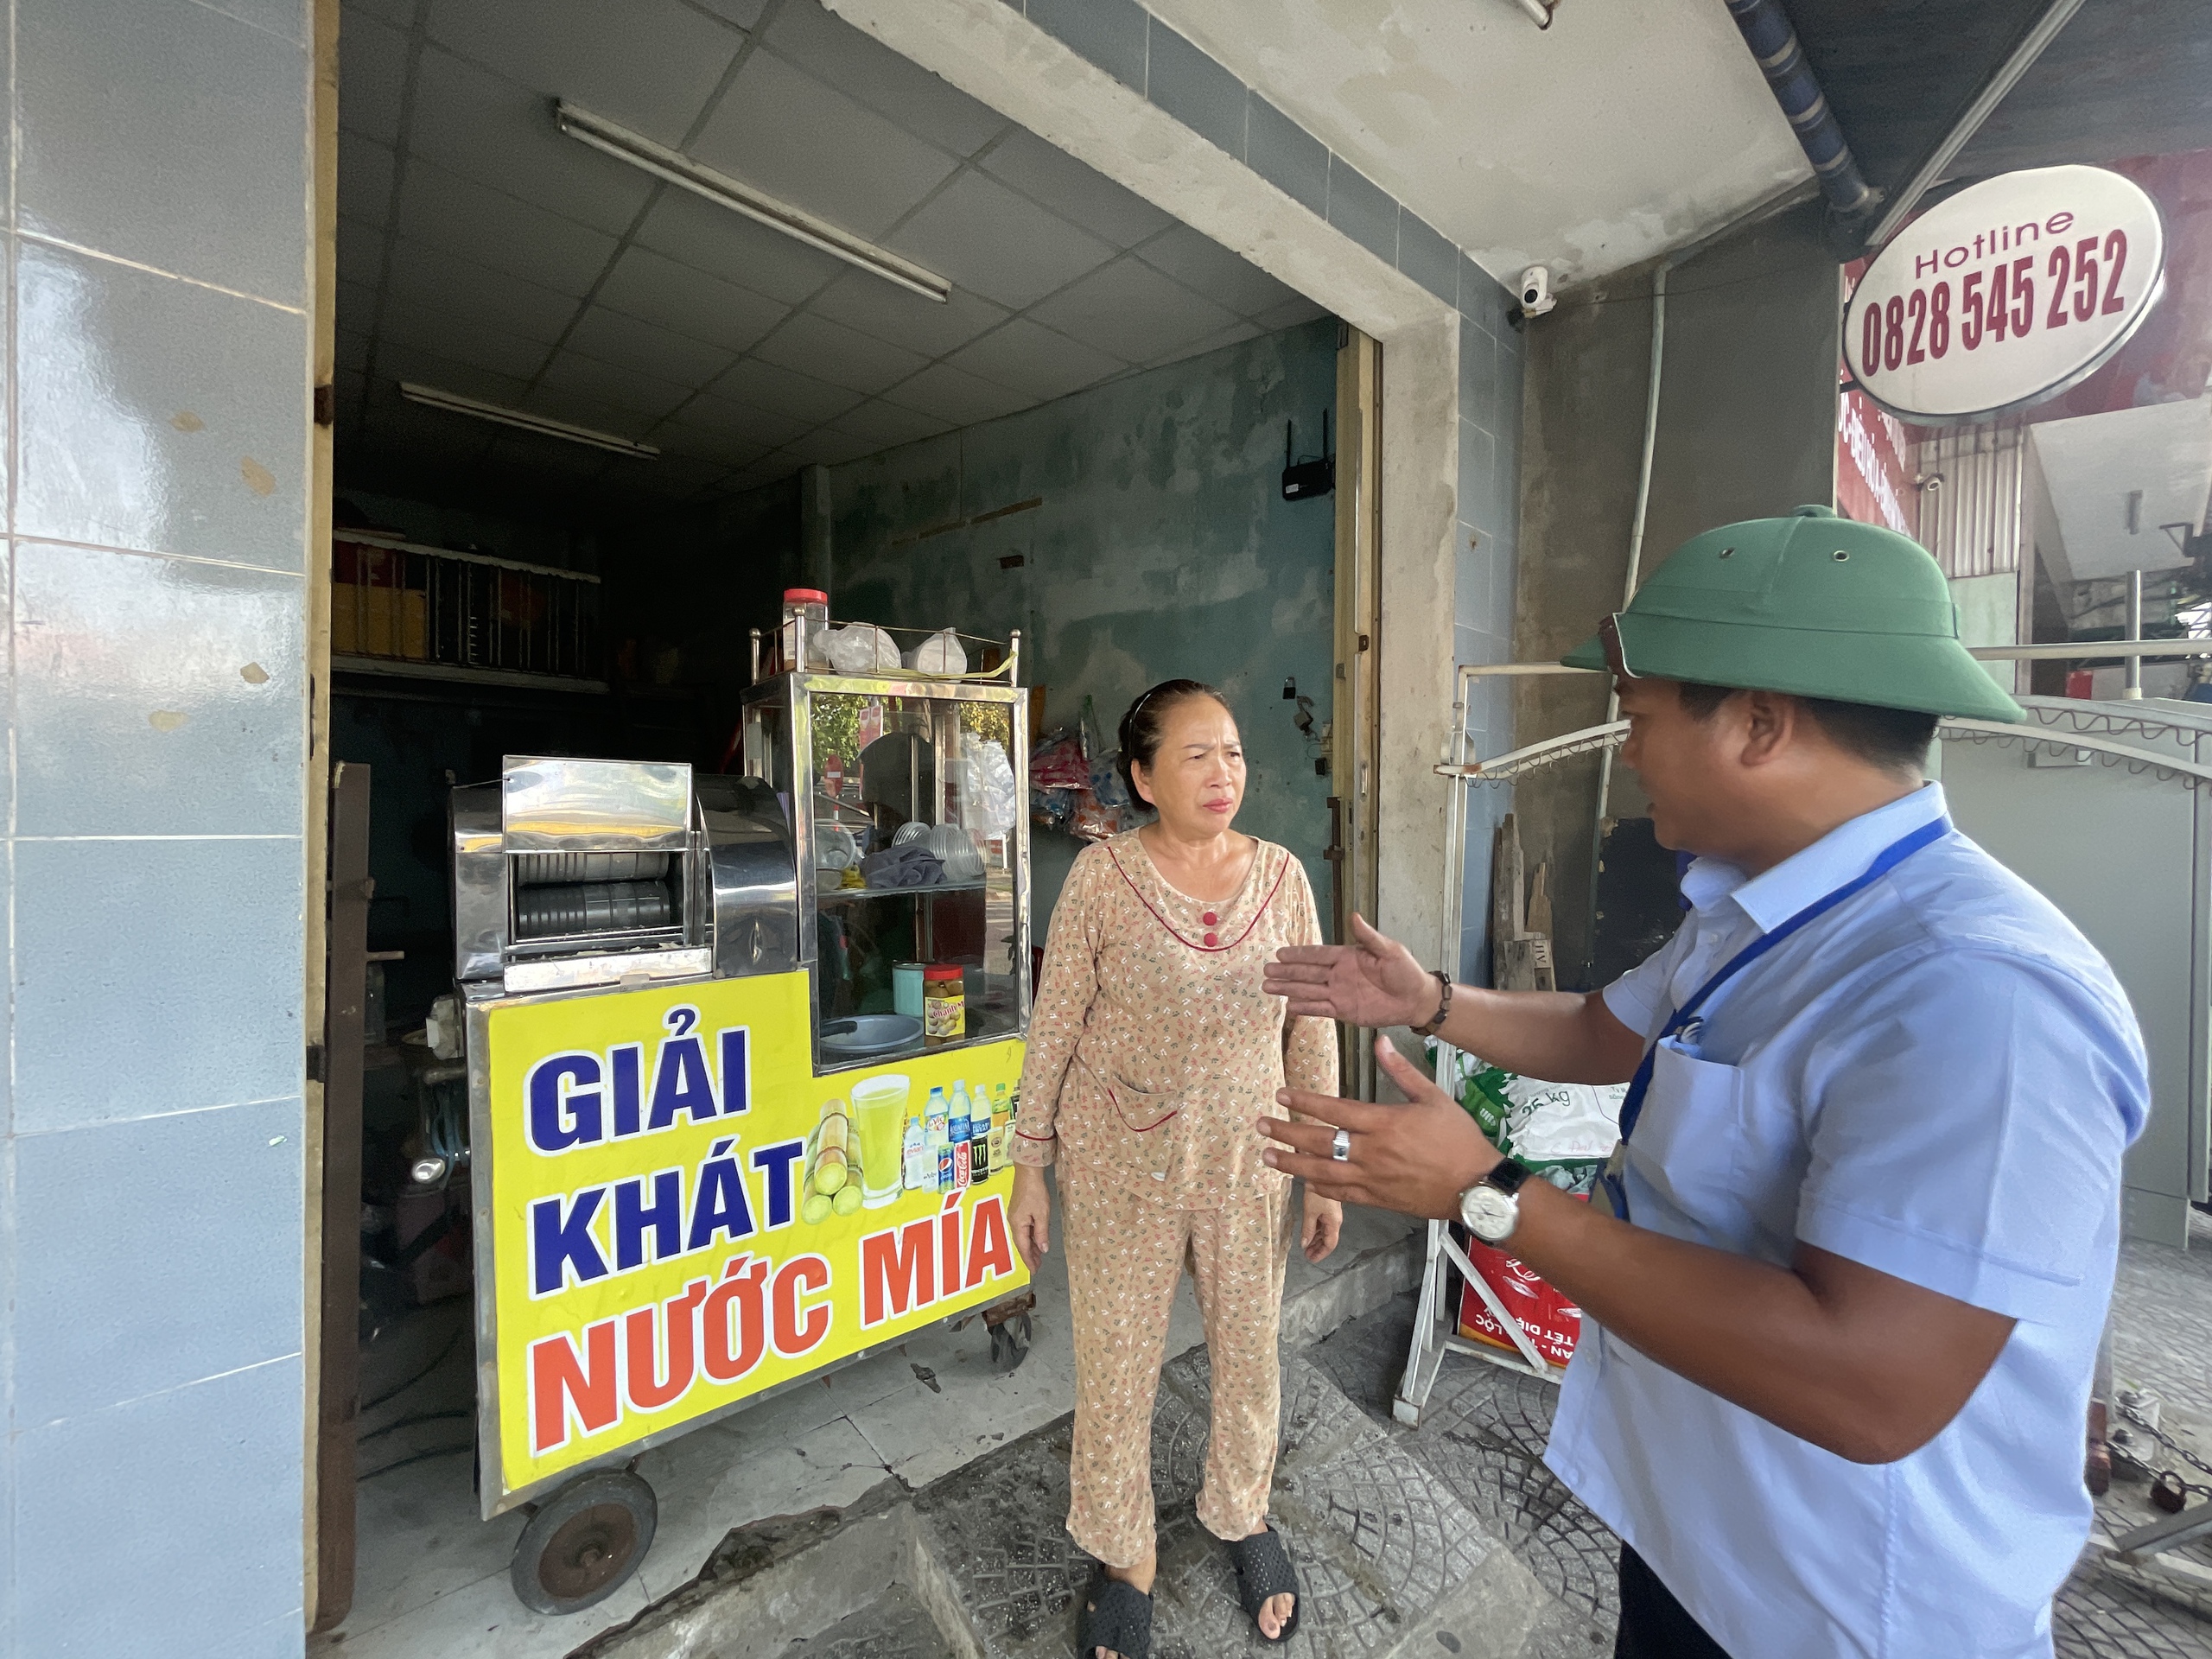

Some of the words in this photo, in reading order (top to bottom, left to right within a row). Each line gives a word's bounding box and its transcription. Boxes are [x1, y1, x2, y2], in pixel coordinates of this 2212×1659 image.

[1861, 281, 1951, 378] 0828
[1961, 255, 2035, 351] 545
[2046, 229, 2128, 329] 252
[1915, 211, 2074, 279] Hotline
[529, 1007, 748, 1152] GIẢI
[1546, 1090, 1571, 1107] kg
[531, 1138, 804, 1295] KHÁT
[532, 1254, 830, 1453] NƯỚC
[862, 1192, 1015, 1327] MÍA
[1544, 1329, 1573, 1346] TẾT
